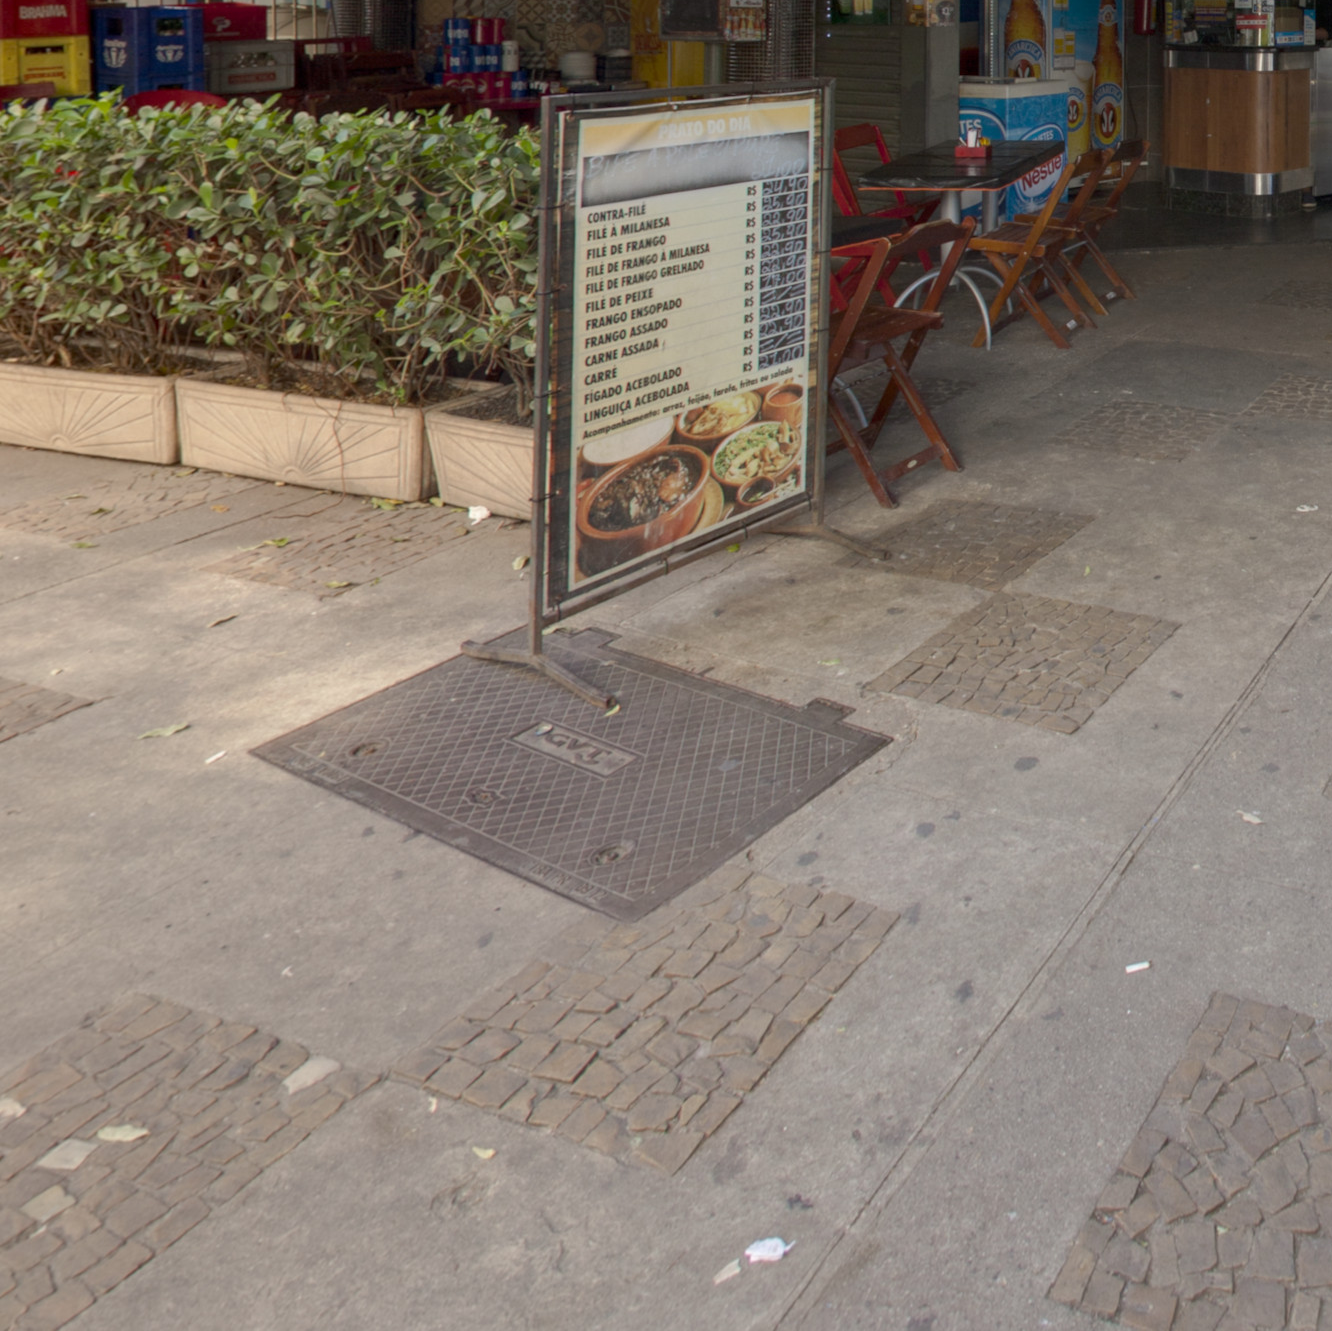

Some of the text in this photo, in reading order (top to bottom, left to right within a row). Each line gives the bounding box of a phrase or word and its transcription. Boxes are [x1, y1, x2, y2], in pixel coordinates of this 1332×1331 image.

[19, 4, 68, 19] BRAHMA
[658, 116, 751, 140] PRATO DO DIA
[587, 202, 646, 224] CONTRA-FILÉ
[747, 185, 757, 196] R$
[587, 224, 608, 241] FILÉ
[620, 217, 670, 235] MILANESA
[746, 201, 756, 212] R$
[586, 243, 607, 260] FILÉ
[610, 244, 623, 256] DE
[626, 235, 667, 252] FRANGO
[746, 217, 756, 228] R$
[586, 261, 605, 278] FILÉ
[607, 261, 619, 274] DE
[621, 253, 658, 270] FRANGO
[669, 243, 710, 260] MILANESA
[745, 233, 755, 244] R$
[585, 278, 605, 295] FILÉ
[607, 278, 619, 290] DE
[621, 270, 658, 287] FRANGO
[660, 260, 705, 278] GRELHADO
[745, 249, 755, 260] R$
[585, 296, 606, 313] FILÉ
[609, 296, 622, 308] DE
[625, 288, 654, 304] PEIXE
[745, 265, 754, 276] R$
[585, 311, 628, 330] FRANGO
[631, 298, 682, 320] ENSOPADO
[744, 281, 754, 292] R$
[585, 296, 754, 349] FRANGO ASSADO R$
[584, 364, 618, 386] CARRÉ
[743, 328, 753, 340] R$
[585, 349, 618, 367] CARNE
[621, 338, 659, 358] ASSADA
[744, 312, 754, 324] R$
[584, 345, 753, 405] FÍGADO ACEBOLADO R$
[584, 400, 631, 423] LINGUIÇA
[634, 381, 690, 408] ACEBOLADA
[743, 361, 753, 372] R$
[583, 409, 660, 440] Acompanhamento:
[740, 375, 758, 389] fritas
[545, 733, 613, 761] GVT
